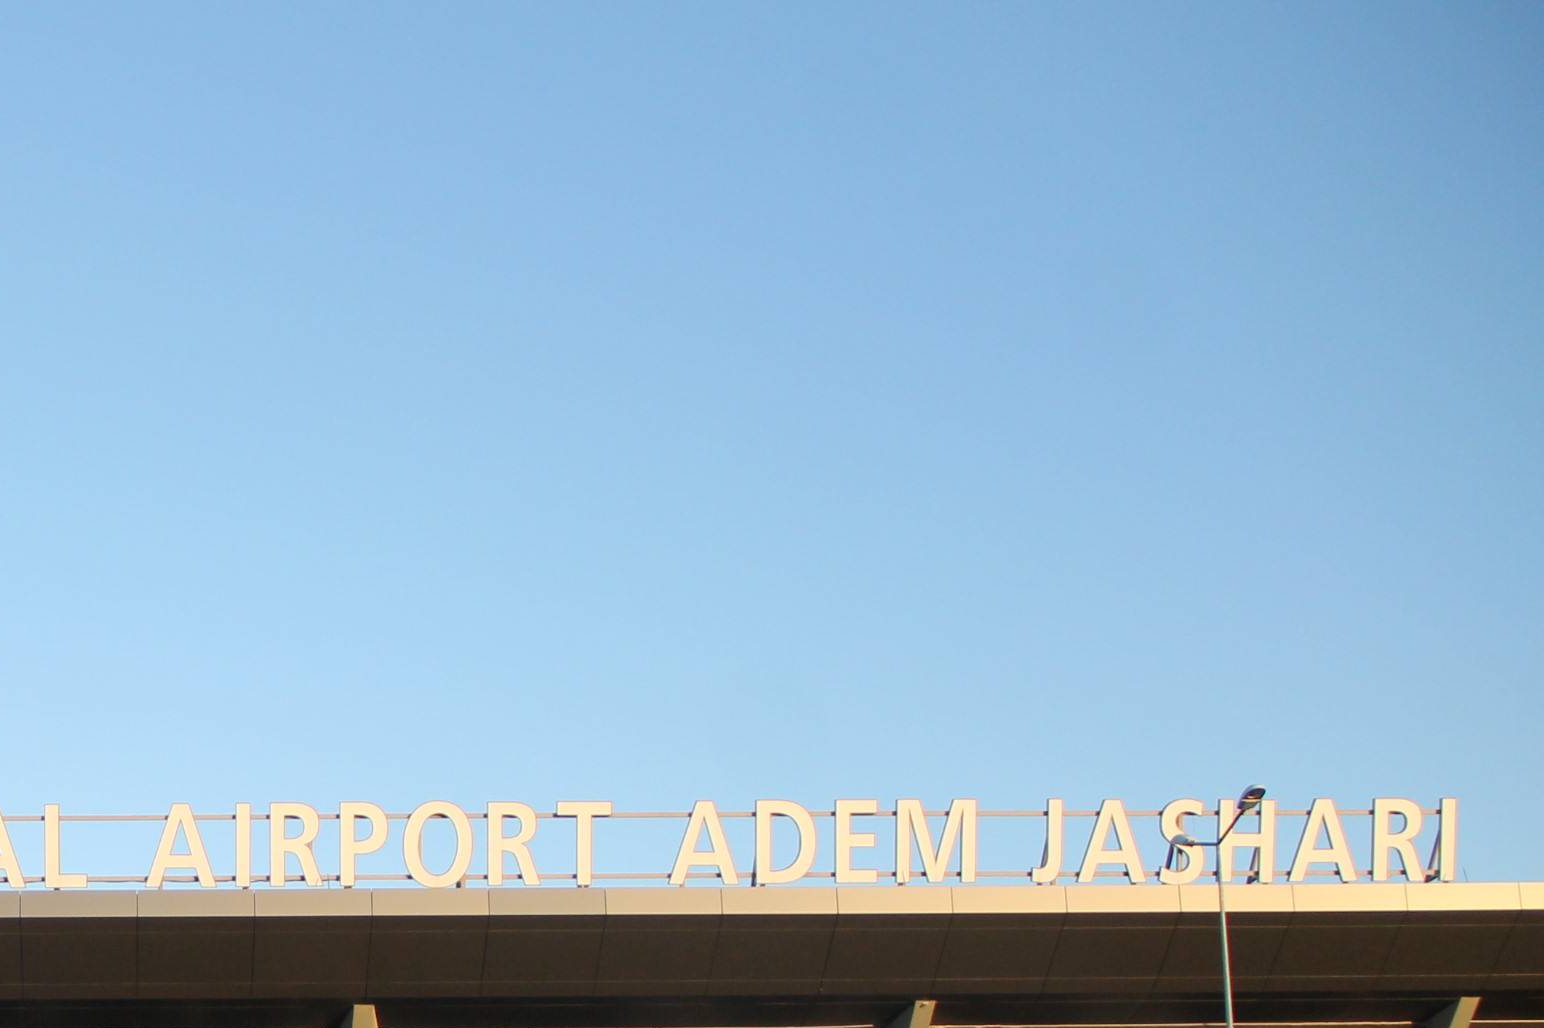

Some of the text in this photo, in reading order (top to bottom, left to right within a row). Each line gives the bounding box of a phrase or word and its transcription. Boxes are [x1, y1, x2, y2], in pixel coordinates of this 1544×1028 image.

[145, 801, 612, 889] AIRPORT
[668, 799, 977, 885] ADEM
[1032, 797, 1457, 884] JASHARI
